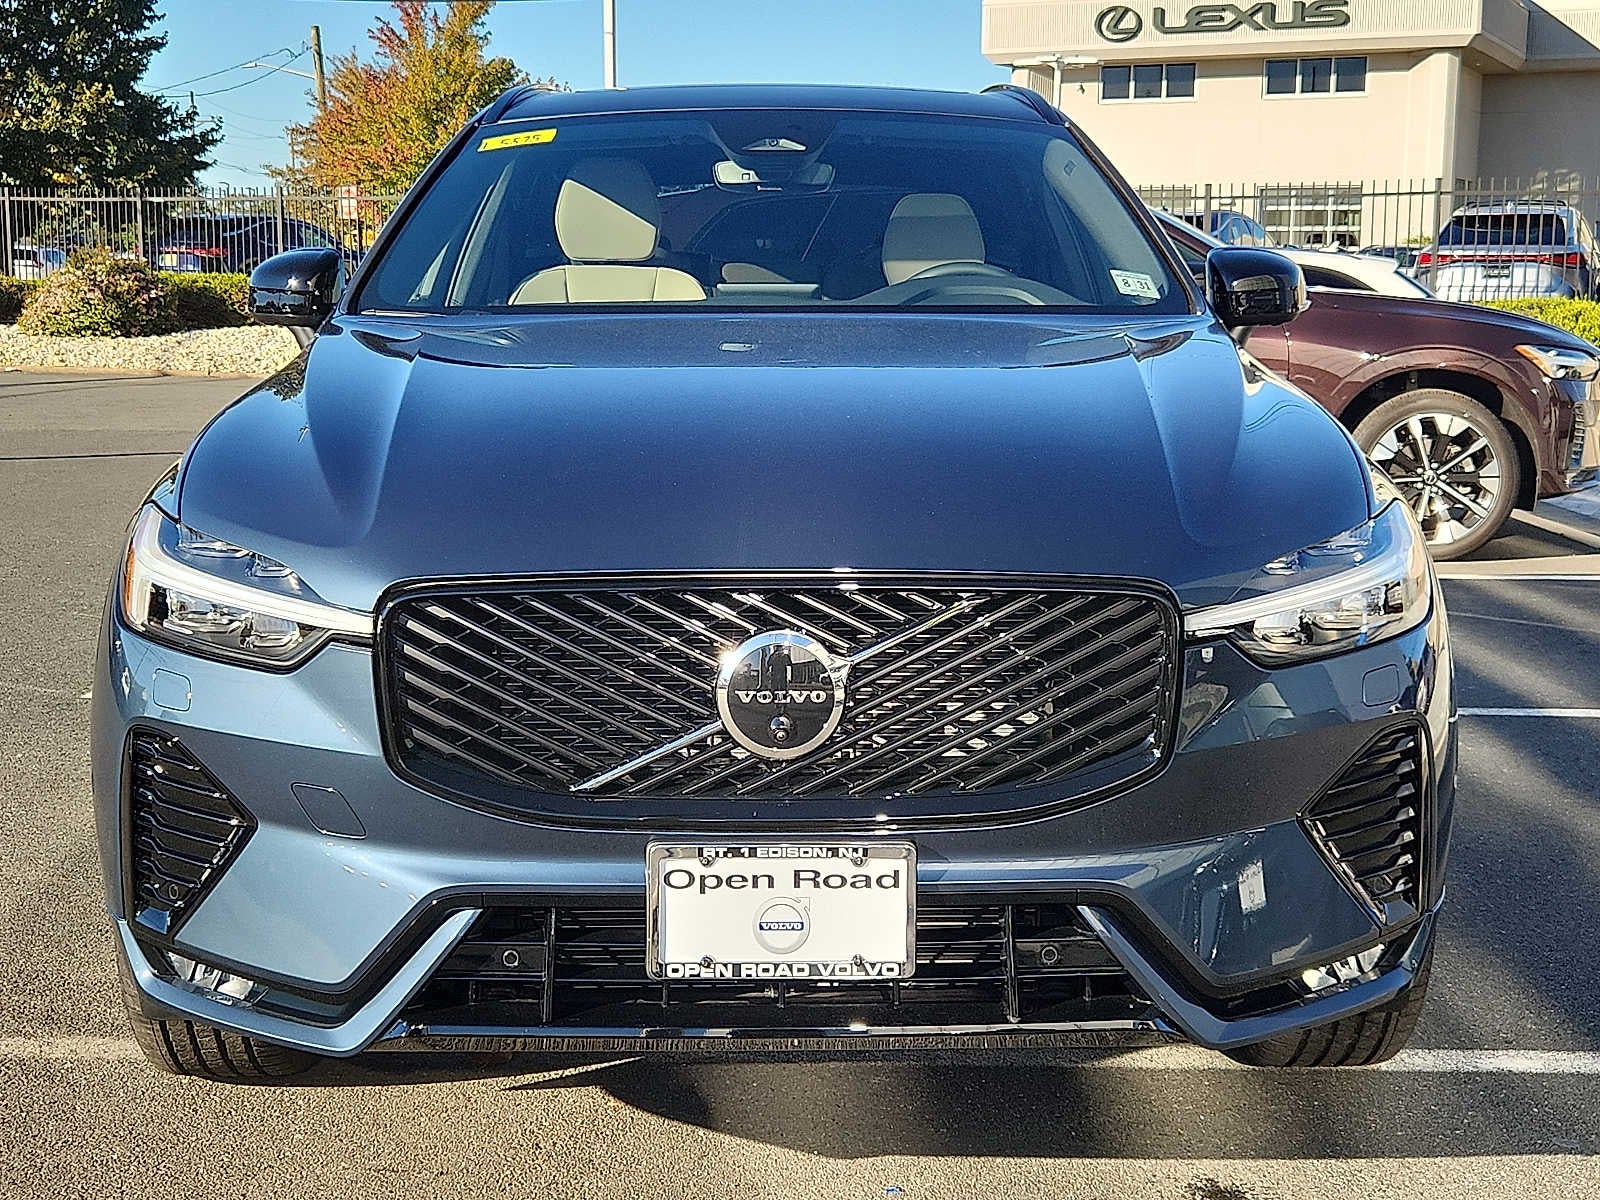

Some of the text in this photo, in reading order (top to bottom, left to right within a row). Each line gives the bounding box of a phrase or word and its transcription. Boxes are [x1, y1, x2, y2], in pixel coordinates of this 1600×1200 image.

[1153, 0, 1351, 34] LEXUS
[1136, 280, 1152, 291] 31
[735, 690, 827, 704] VOLVO
[702, 847, 731, 858] RT.
[740, 847, 750, 858] 1
[838, 847, 865, 858] NJ
[663, 868, 900, 894] Open Road
[761, 922, 803, 930] VOLVO
[666, 962, 900, 978] OPEN ROAD VOLVO
